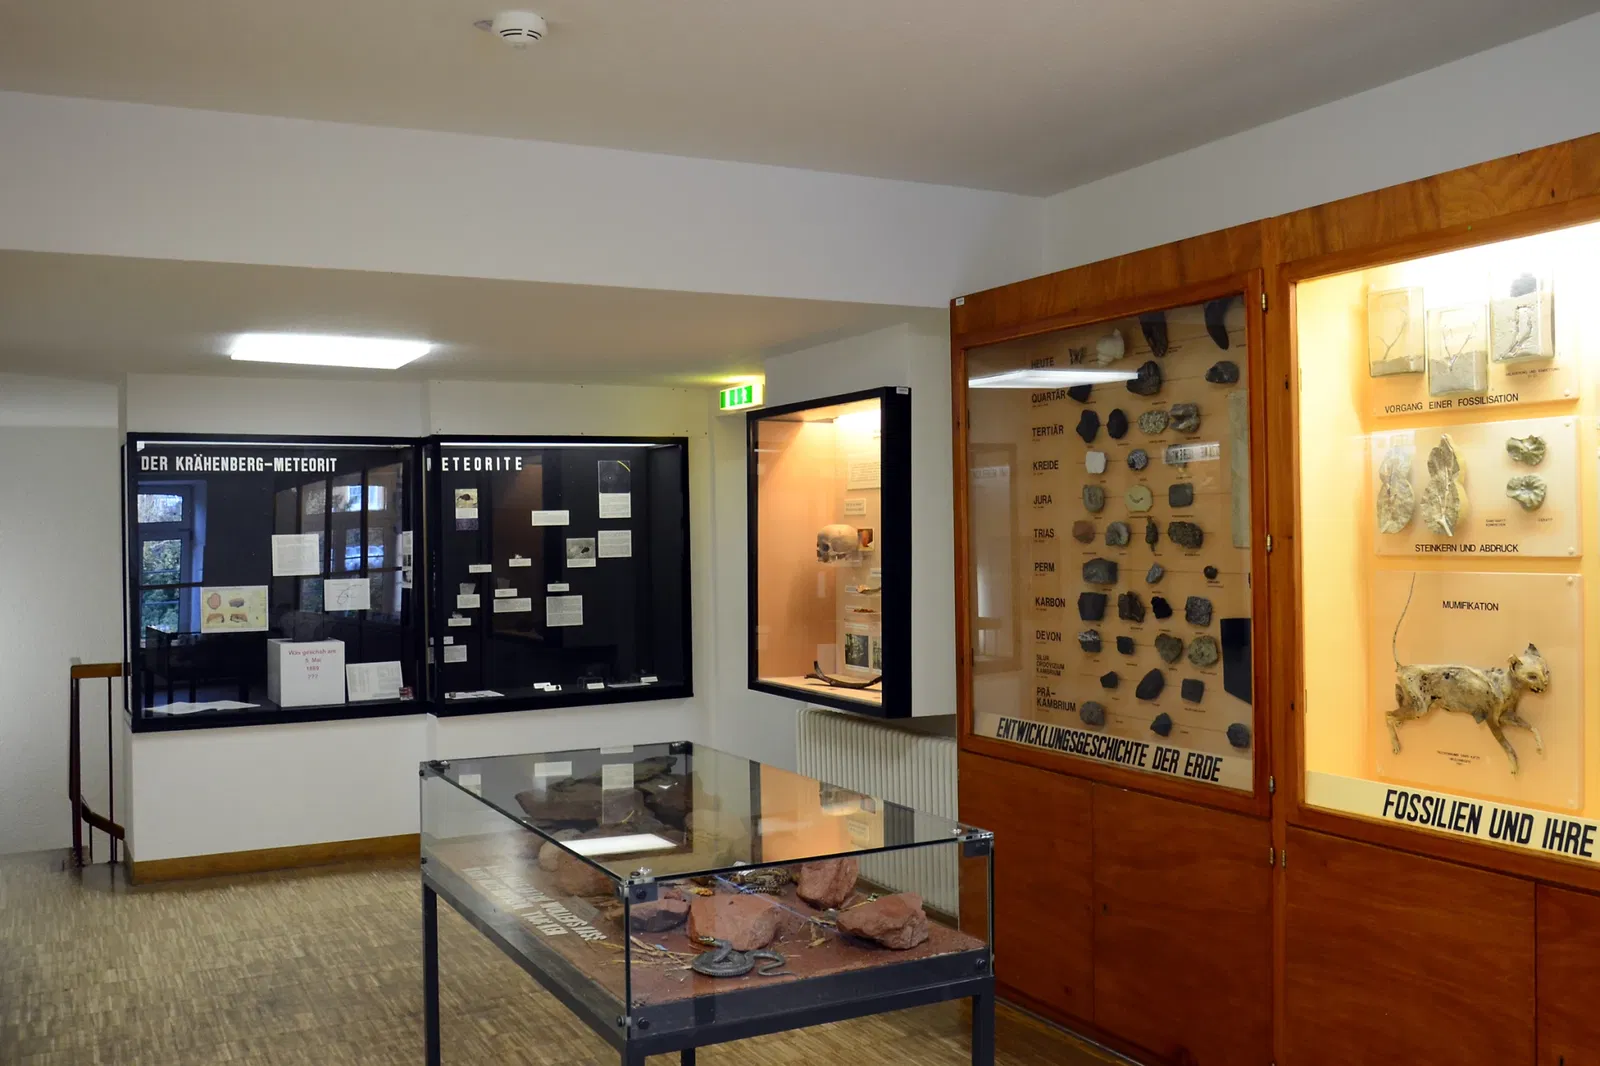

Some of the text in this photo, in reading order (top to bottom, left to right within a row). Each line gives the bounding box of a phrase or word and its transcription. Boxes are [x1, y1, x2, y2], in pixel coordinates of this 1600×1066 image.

[1031, 389, 1066, 403] QUARTÄR
[1385, 392, 1519, 414] VORGANG EINER FOSSILISATION
[1032, 424, 1064, 437] TERTIÄR
[141, 456, 168, 472] DER
[1032, 460, 1059, 471] KREIDE
[1033, 494, 1053, 505] JURA
[1034, 528, 1055, 539] TRIAS
[1415, 543, 1519, 553] STEINKERN UND ABDRUCK
[1034, 561, 1055, 573] PERM
[1035, 596, 1065, 608] KARBON
[1442, 600, 1499, 612] MUMIFIKATION
[1036, 630, 1061, 642] DEVON
[1036, 697, 1076, 712] KAMBRIUM
[996, 717, 1223, 783] ENTWICKLUNGSGESCHICHTE DER ERDE
[1382, 788, 1598, 858] FOSSILIEN UND IHRE
